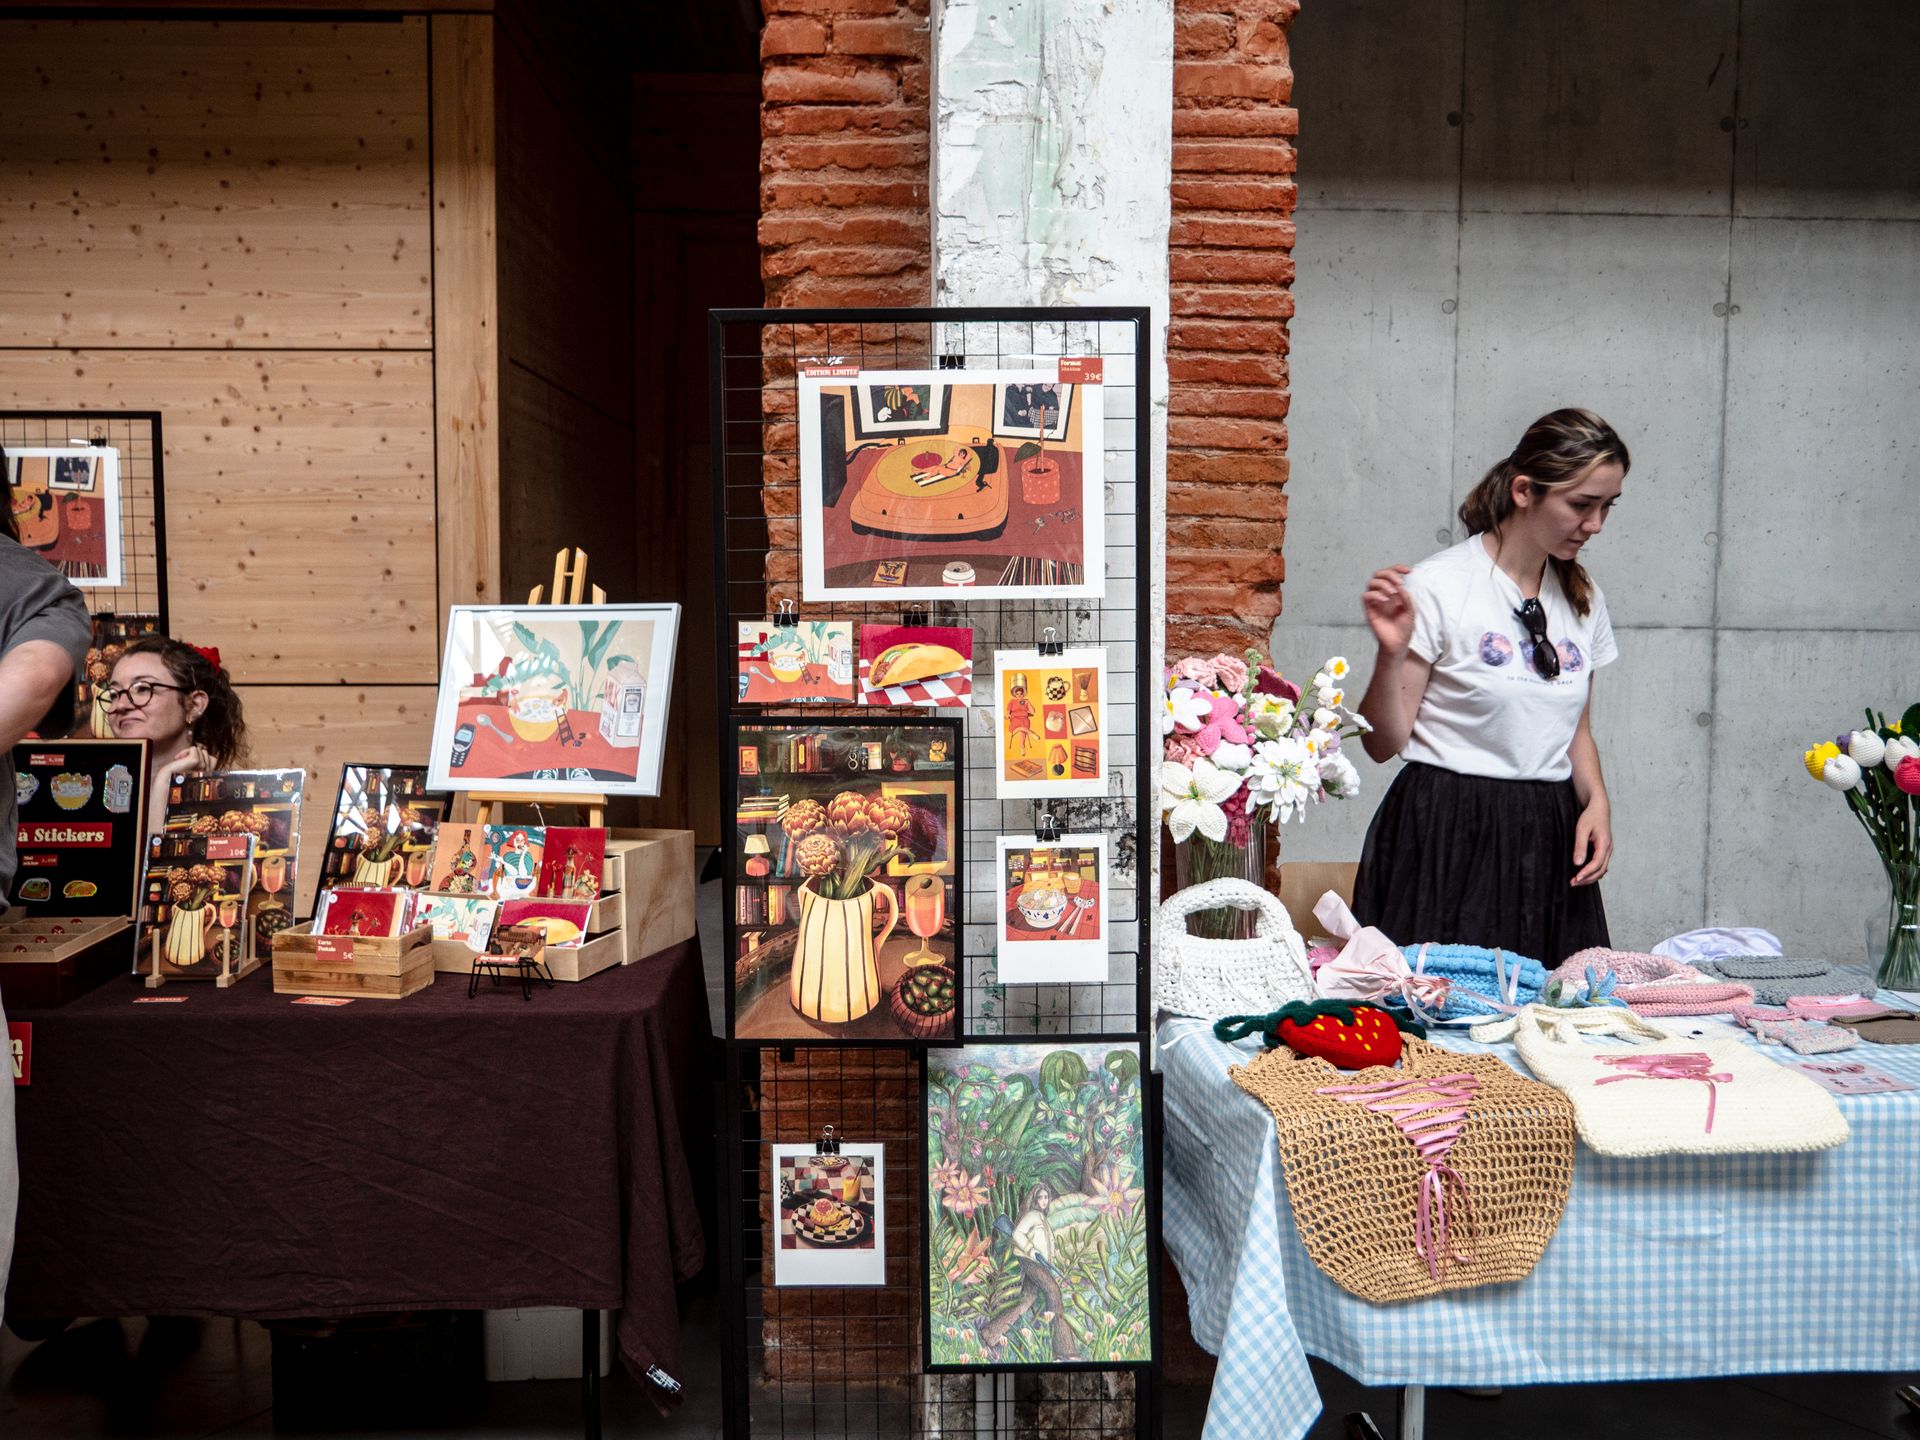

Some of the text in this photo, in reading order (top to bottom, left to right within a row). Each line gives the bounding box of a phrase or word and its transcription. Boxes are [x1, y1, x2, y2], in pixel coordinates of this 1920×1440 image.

[1084, 372, 1102, 381] 39€
[18, 828, 104, 842] à Stickers
[343, 952, 354, 960] 5€
